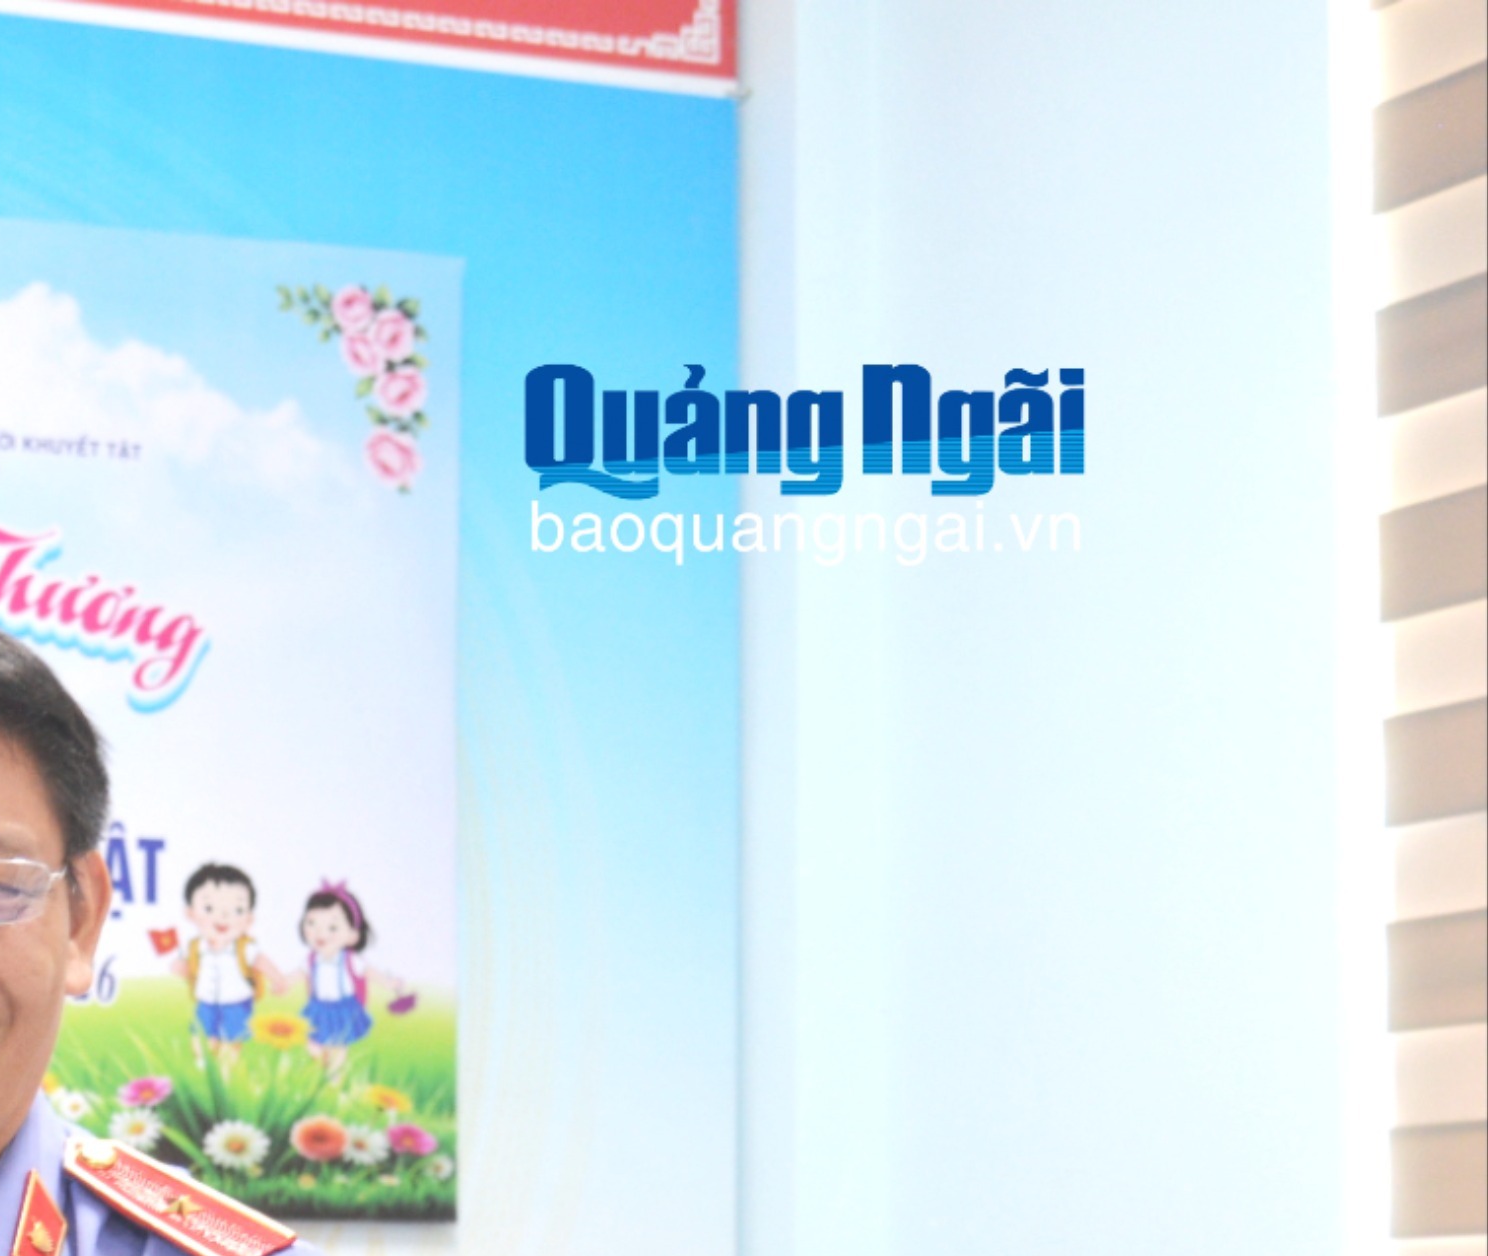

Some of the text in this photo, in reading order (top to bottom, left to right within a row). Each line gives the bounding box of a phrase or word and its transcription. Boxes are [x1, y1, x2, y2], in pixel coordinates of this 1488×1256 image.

[23, 434, 99, 458] KHUYẾT
[106, 438, 141, 460] TẬT
[106, 822, 166, 919] ẬT
